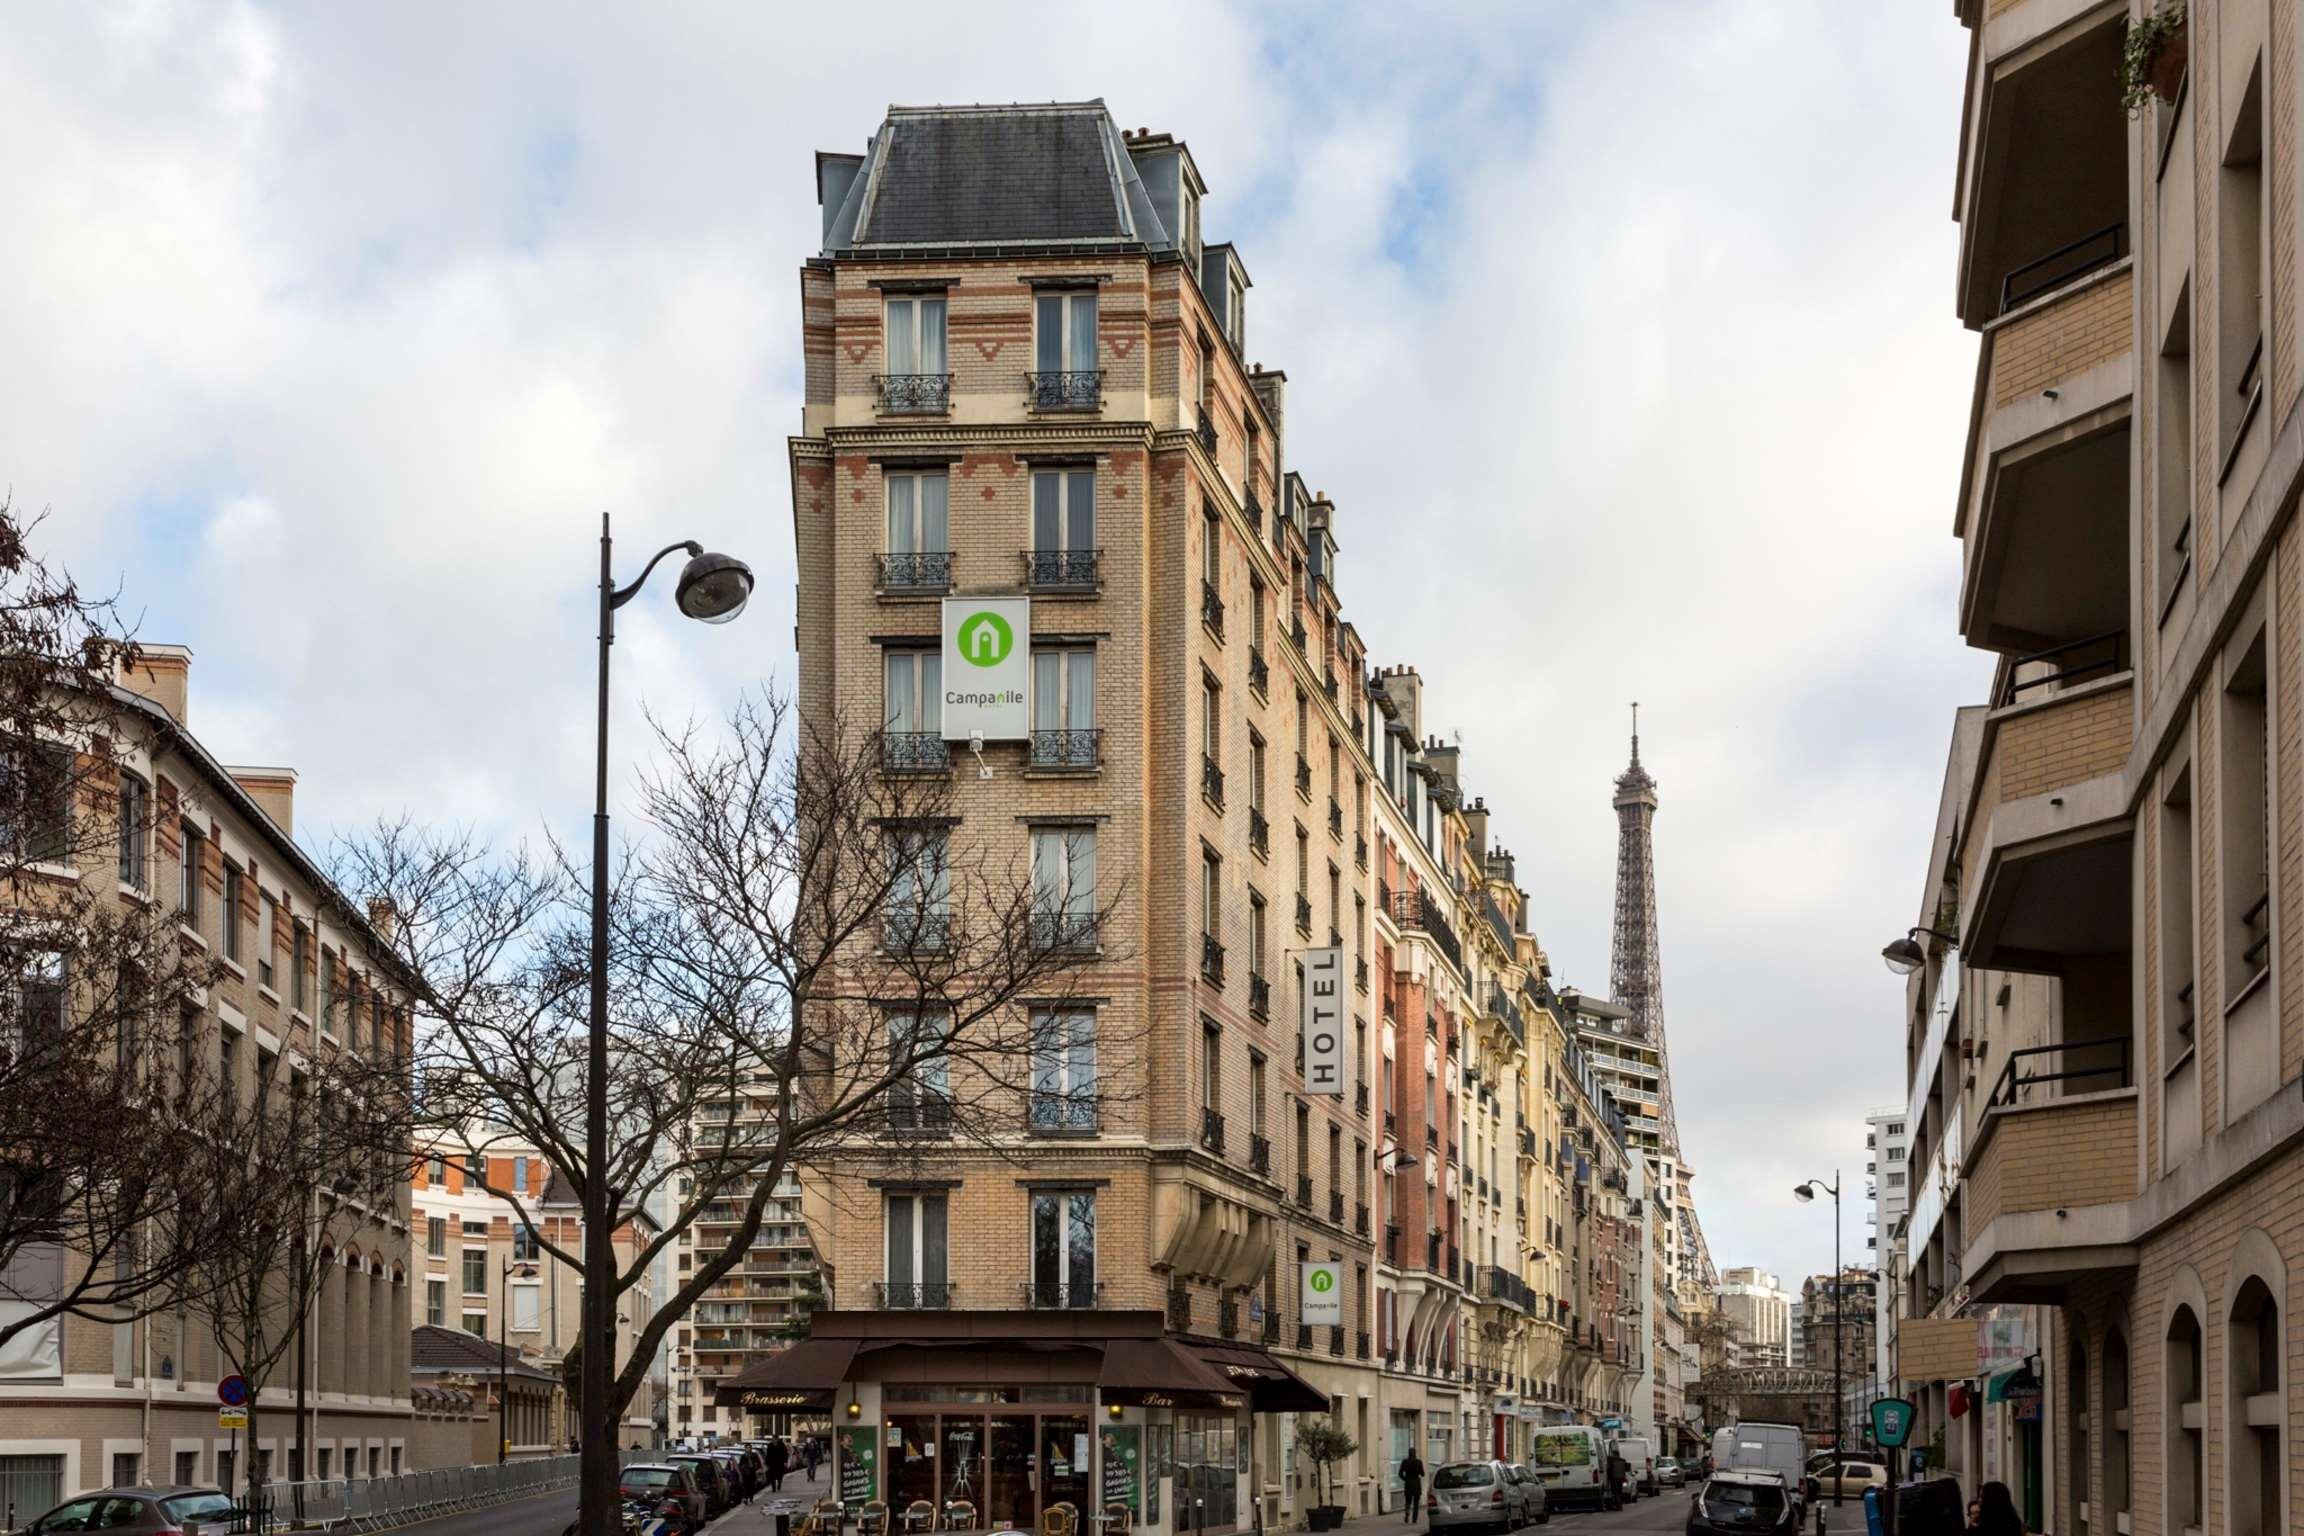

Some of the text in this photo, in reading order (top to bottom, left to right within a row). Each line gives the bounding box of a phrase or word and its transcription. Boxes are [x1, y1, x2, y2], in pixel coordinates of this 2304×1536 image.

[945, 691, 1024, 708] Campanile
[1313, 952, 1336, 1084] HOTEL
[740, 1391, 808, 1405] Brasserie
[1142, 1392, 1175, 1406] Bar
